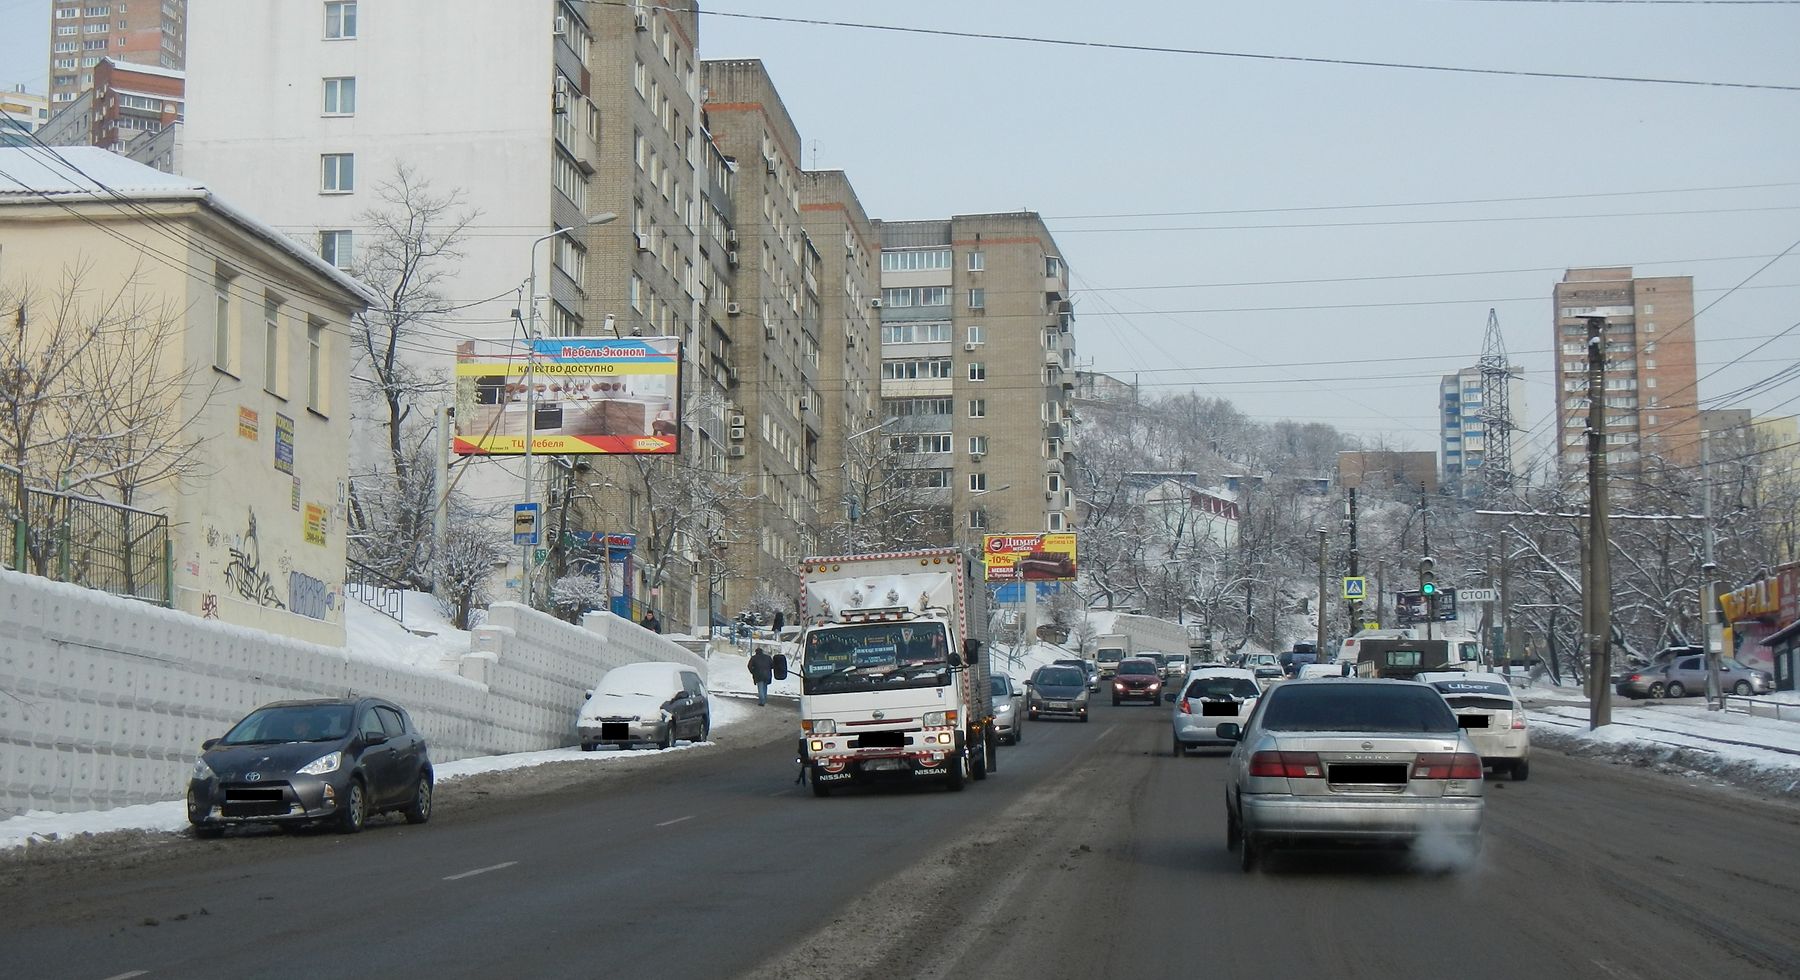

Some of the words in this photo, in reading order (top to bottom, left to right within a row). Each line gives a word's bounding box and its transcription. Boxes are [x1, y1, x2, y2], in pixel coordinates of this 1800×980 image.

[561, 346, 646, 358] МебельЭконом
[518, 365, 562, 373] КАЕСТВО
[564, 365, 614, 374] ДОСТУПНО
[512, 439, 525, 449] ТЦ
[989, 555, 1010, 563] -10%
[1461, 589, 1491, 599] СТОП
[914, 768, 947, 776] NISSAN
[819, 773, 851, 781] NISSAN
